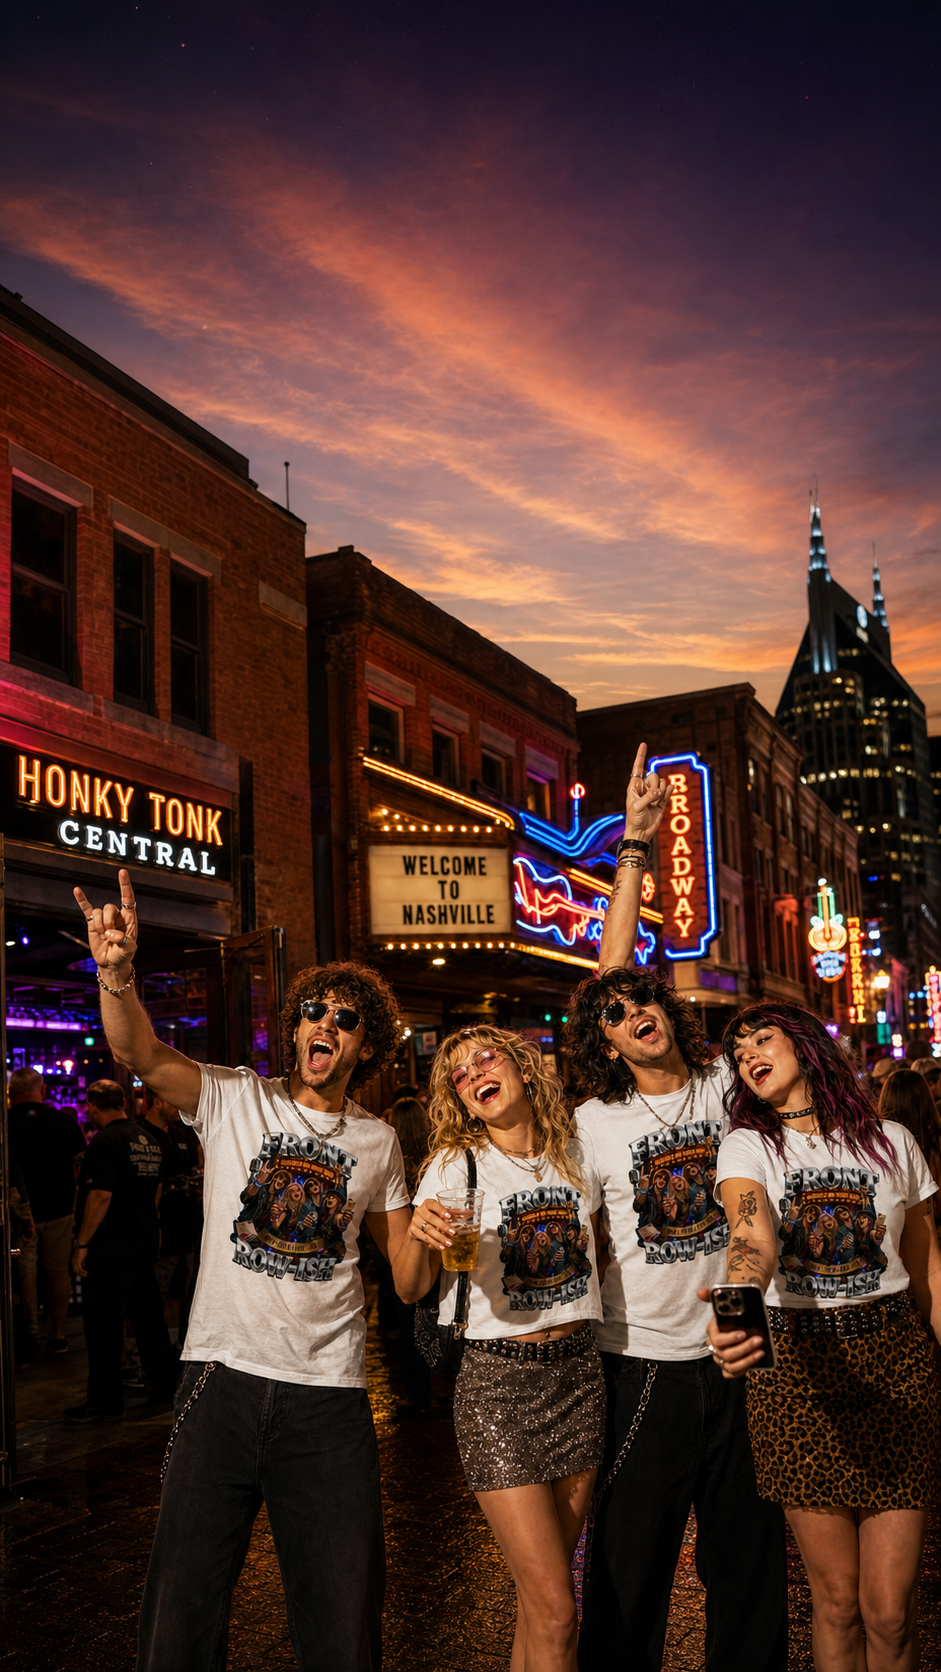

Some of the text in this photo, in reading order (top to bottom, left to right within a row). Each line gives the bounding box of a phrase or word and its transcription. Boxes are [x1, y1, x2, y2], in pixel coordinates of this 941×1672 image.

[18, 754, 224, 846] HONKY TONK
[58, 819, 216, 875] CENTRAL
[402, 855, 487, 876] WELCOME
[668, 773, 695, 938] BROADWAY
[438, 880, 460, 900] TO
[403, 904, 495, 925] NASHVILLE
[259, 1132, 359, 1180] FRONT
[629, 1119, 723, 1168] FRONT
[783, 1165, 880, 1198] FRONT
[499, 1186, 581, 1223] FRONT
[232, 1236, 337, 1282] ROW-ISH
[508, 1275, 589, 1311] ROW-ISH
[785, 1268, 882, 1299] ROW-ISH
